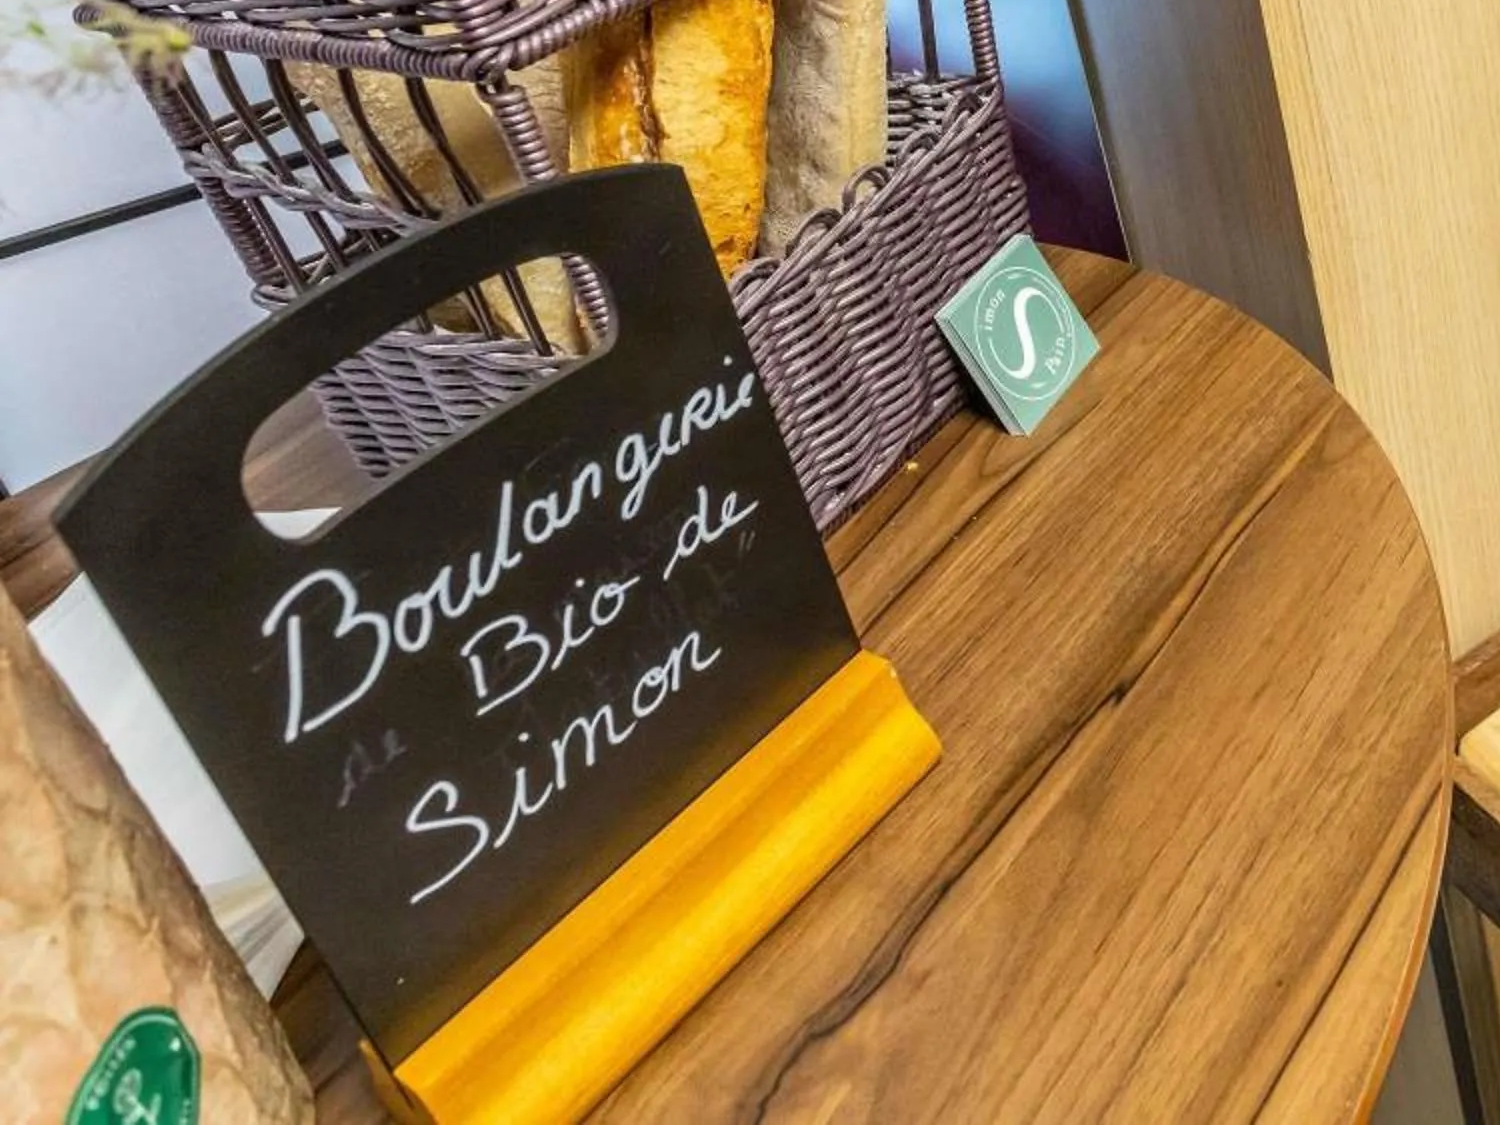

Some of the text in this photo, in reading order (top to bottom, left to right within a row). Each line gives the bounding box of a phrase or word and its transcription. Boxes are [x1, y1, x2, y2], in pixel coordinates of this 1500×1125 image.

[460, 484, 760, 717] Bio de
[403, 629, 722, 905] Simon
